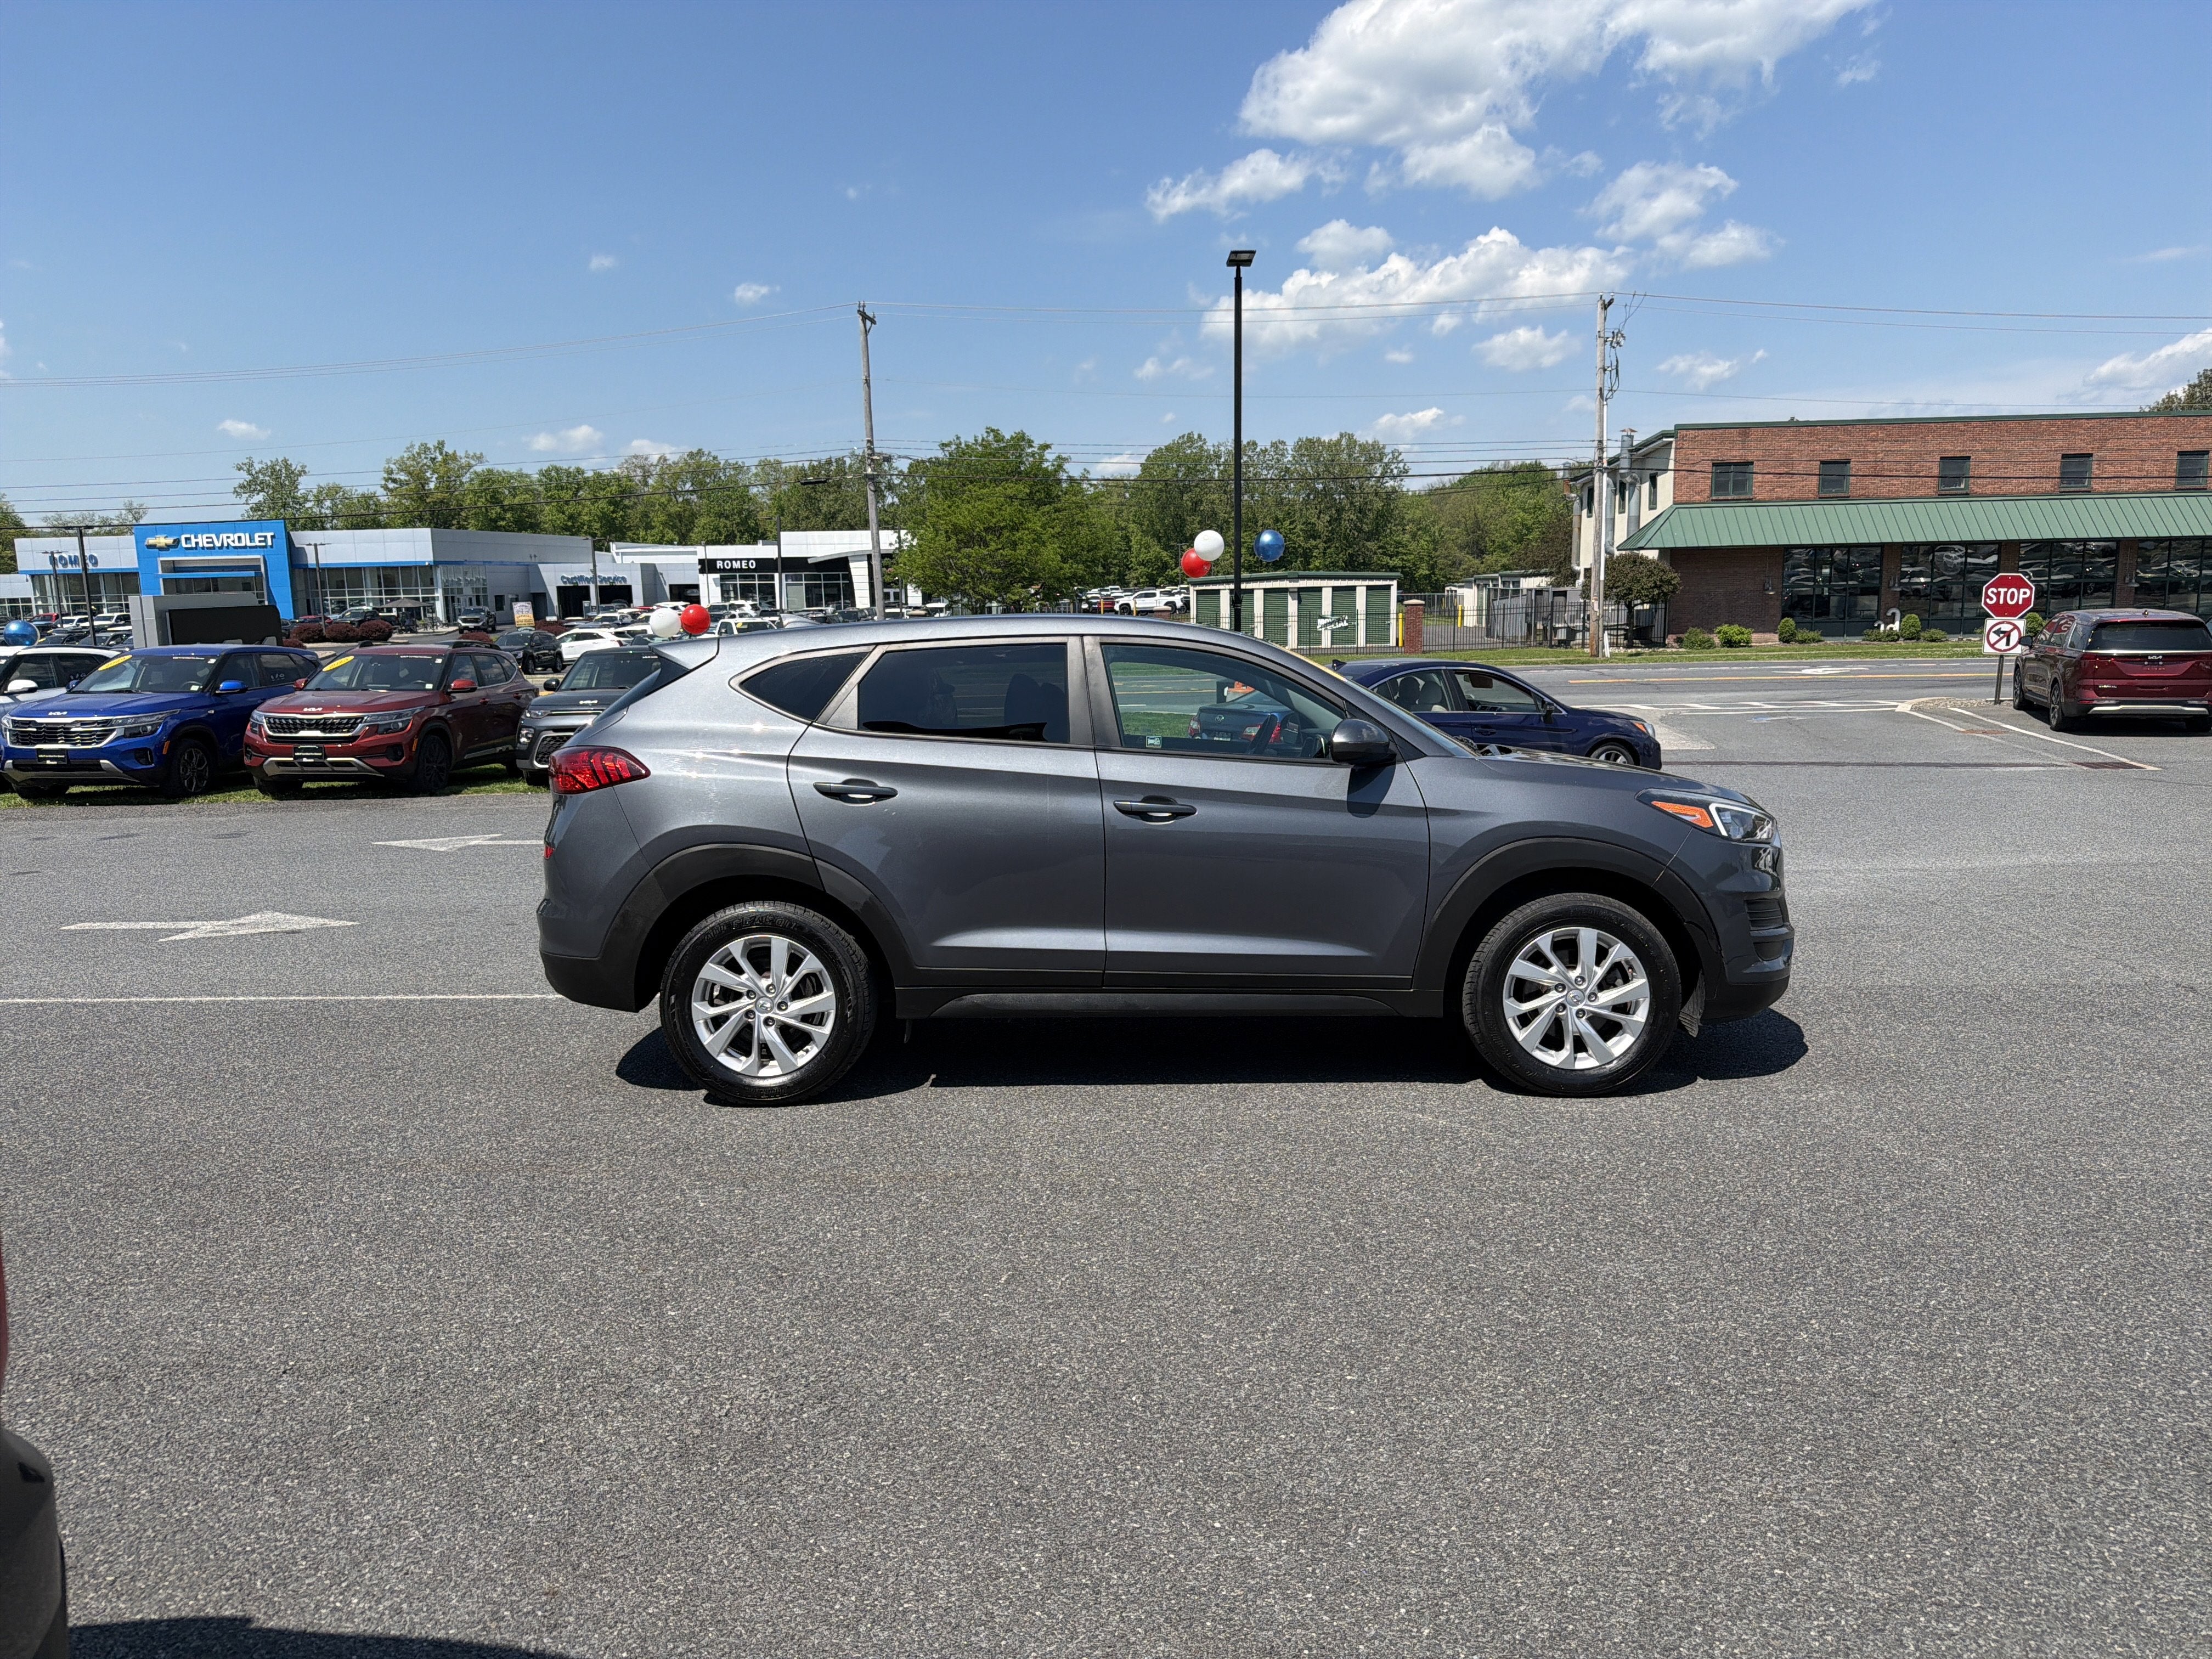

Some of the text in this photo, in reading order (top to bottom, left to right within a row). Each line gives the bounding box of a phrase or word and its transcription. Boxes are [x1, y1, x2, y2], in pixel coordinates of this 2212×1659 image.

[181, 532, 275, 548] CHEVROLET
[716, 560, 756, 569] ROMEO
[1986, 588, 2030, 605] STOP
